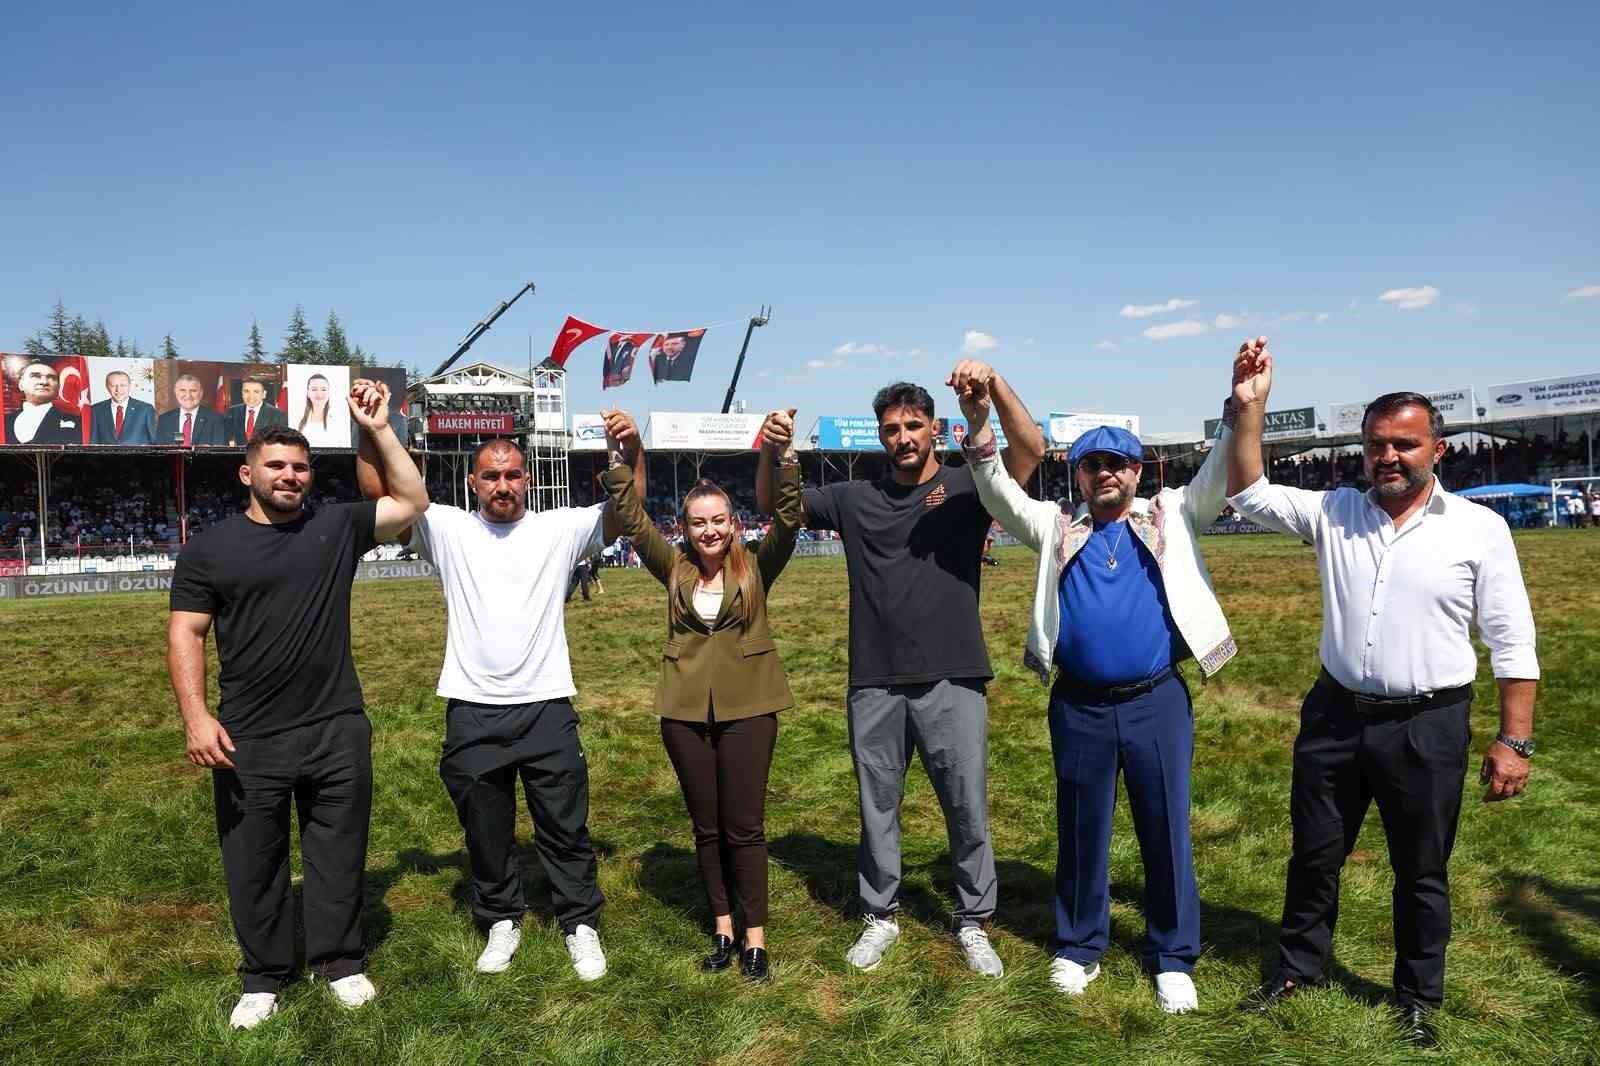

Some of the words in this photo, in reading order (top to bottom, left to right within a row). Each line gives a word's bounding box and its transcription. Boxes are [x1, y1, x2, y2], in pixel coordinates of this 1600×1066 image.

[438, 418, 473, 430] HAKEM
[474, 416, 505, 430] HEYETİ
[368, 560, 432, 578] ÖZÜNLÜ
[24, 577, 109, 595] ÖZÜNLÜ
[119, 574, 172, 591] ÖZÜN
